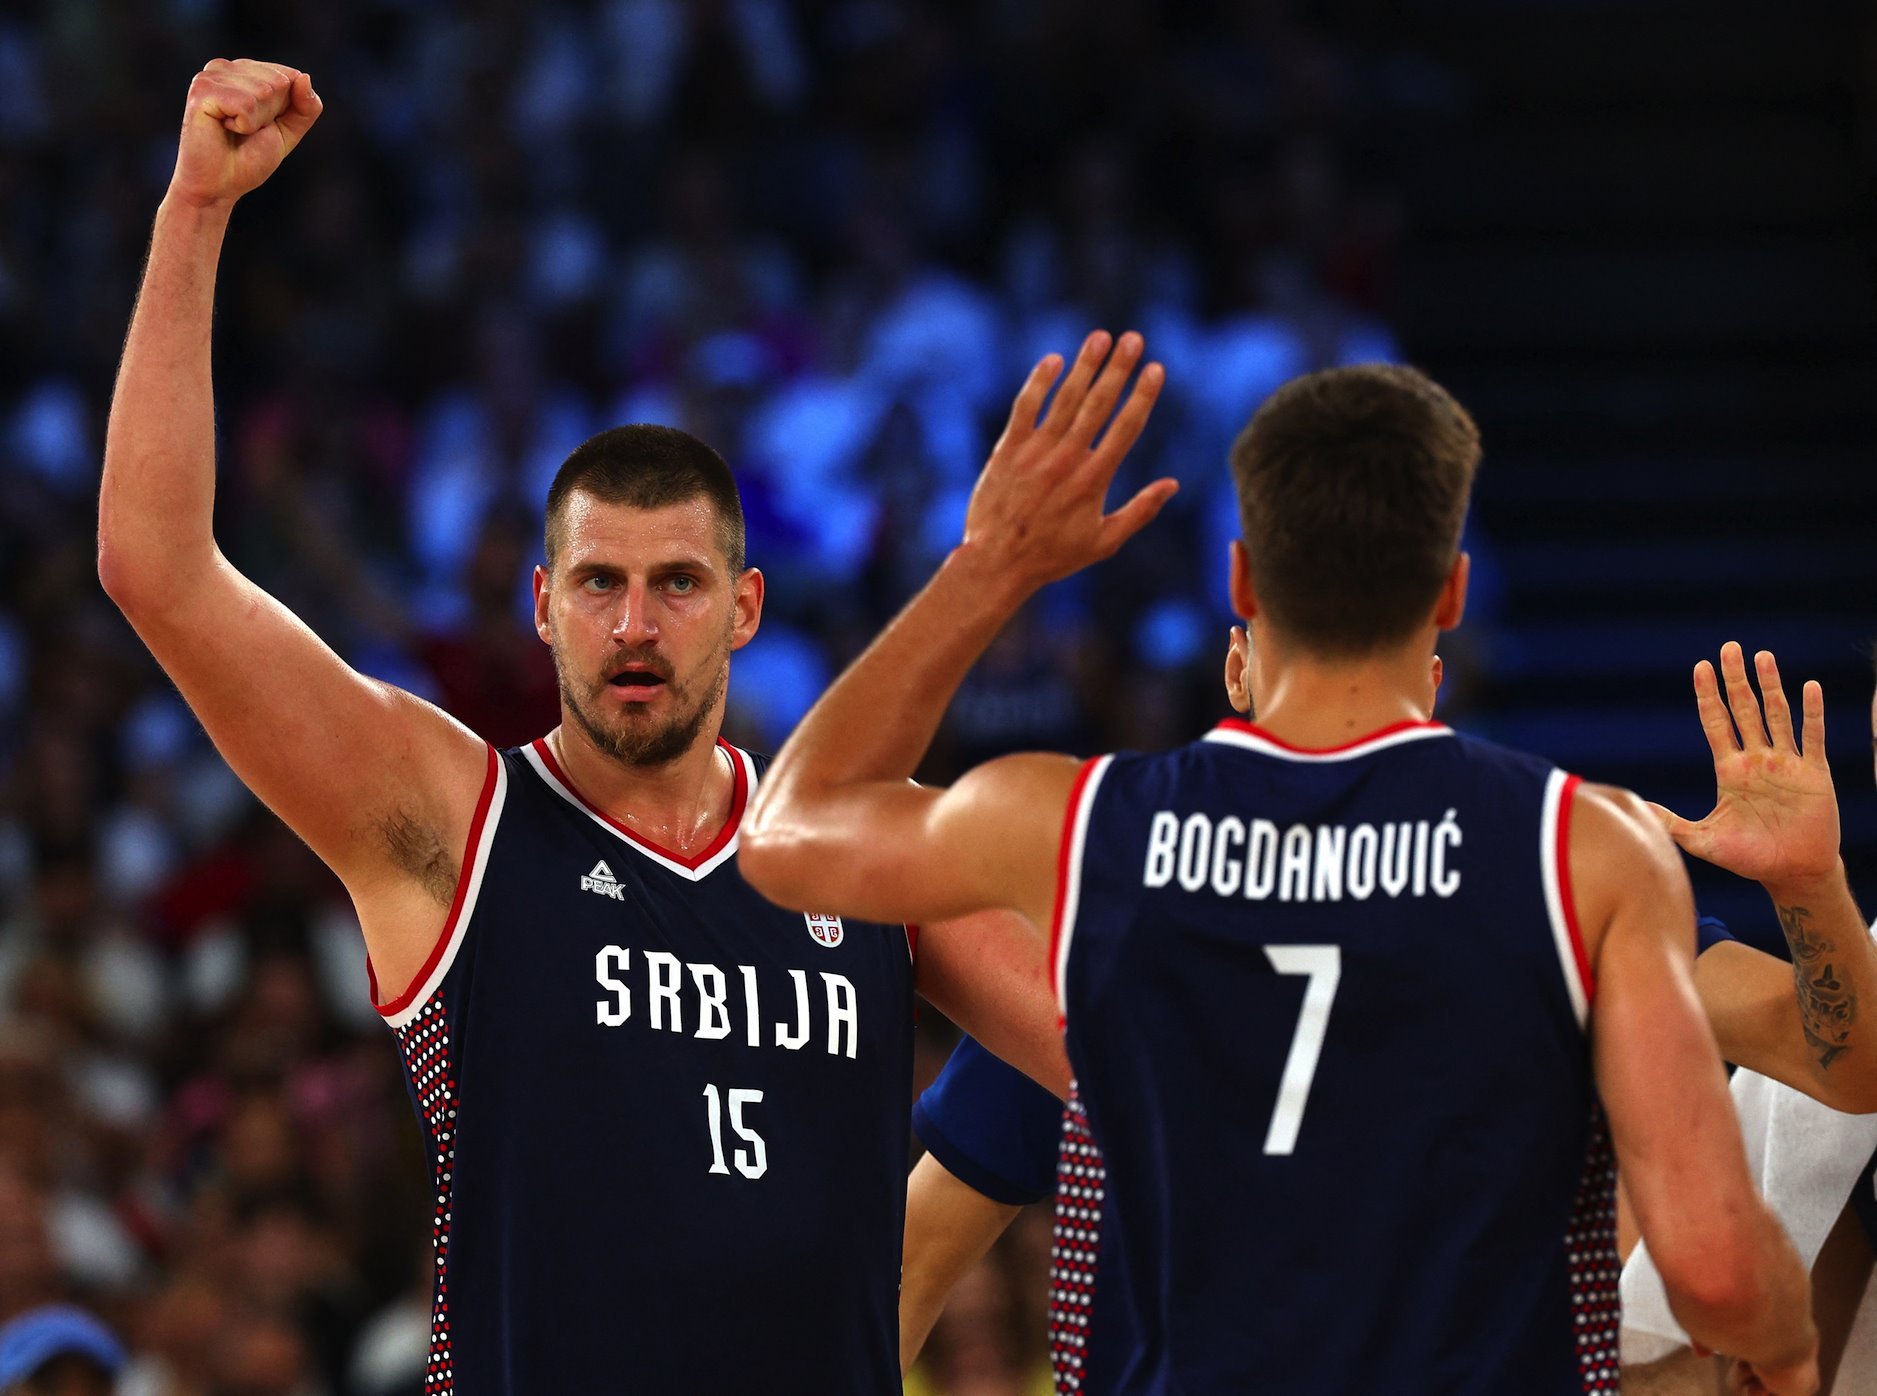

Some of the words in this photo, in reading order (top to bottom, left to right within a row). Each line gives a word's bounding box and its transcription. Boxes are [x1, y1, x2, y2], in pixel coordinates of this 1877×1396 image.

[580, 875, 626, 901] PEAK
[1143, 808, 1462, 902] BOGDANOVIĆ
[595, 944, 858, 1060] SRBIJA
[1263, 944, 1341, 1155] 7
[702, 1083, 768, 1180] 15
